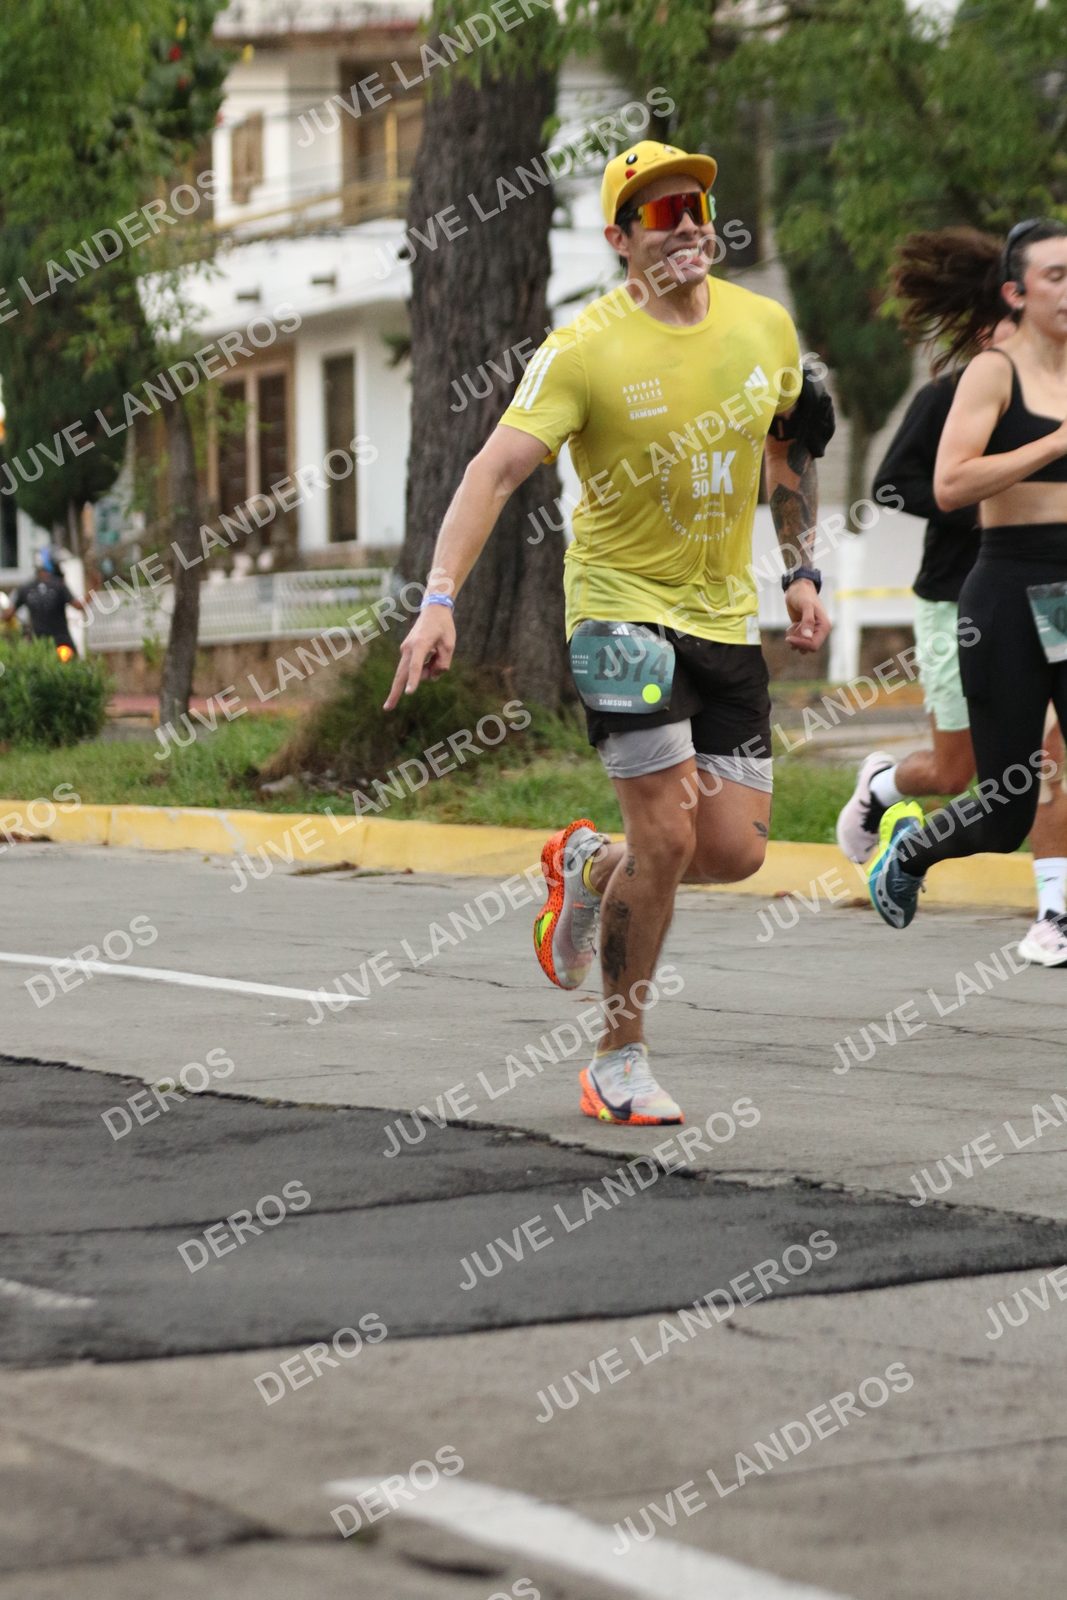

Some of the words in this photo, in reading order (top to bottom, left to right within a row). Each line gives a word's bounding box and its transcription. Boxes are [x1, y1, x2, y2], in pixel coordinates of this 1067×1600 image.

[691, 453, 708, 473] 15
[711, 450, 737, 495] K
[692, 480, 709, 499] 30
[599, 699, 632, 707] SAMSUNG
